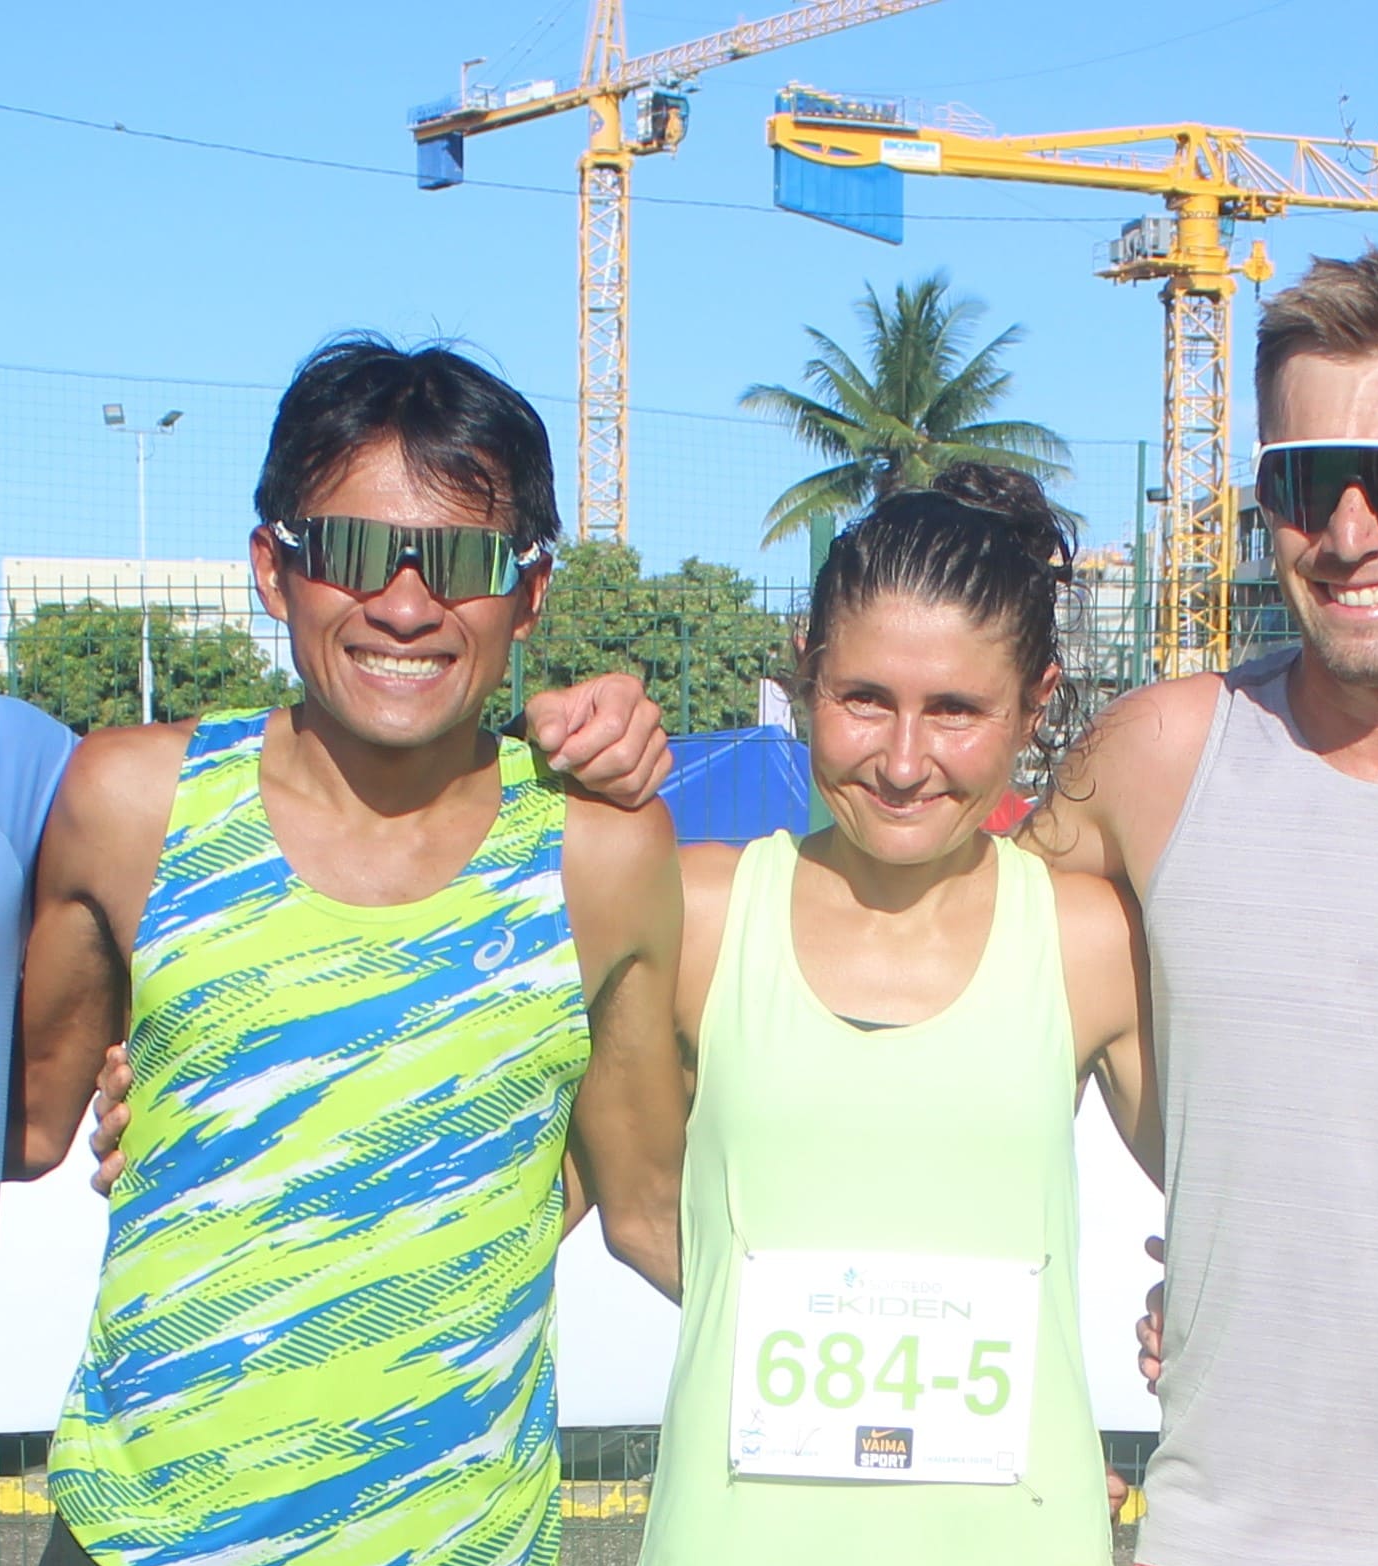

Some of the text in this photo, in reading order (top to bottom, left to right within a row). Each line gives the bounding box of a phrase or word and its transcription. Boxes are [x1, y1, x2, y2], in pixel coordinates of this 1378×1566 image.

[808, 1293, 972, 1320] EKIDEN
[756, 1329, 1013, 1417] 684-5
[861, 1438, 907, 1454] VAIMA
[859, 1453, 908, 1469] SPORT
